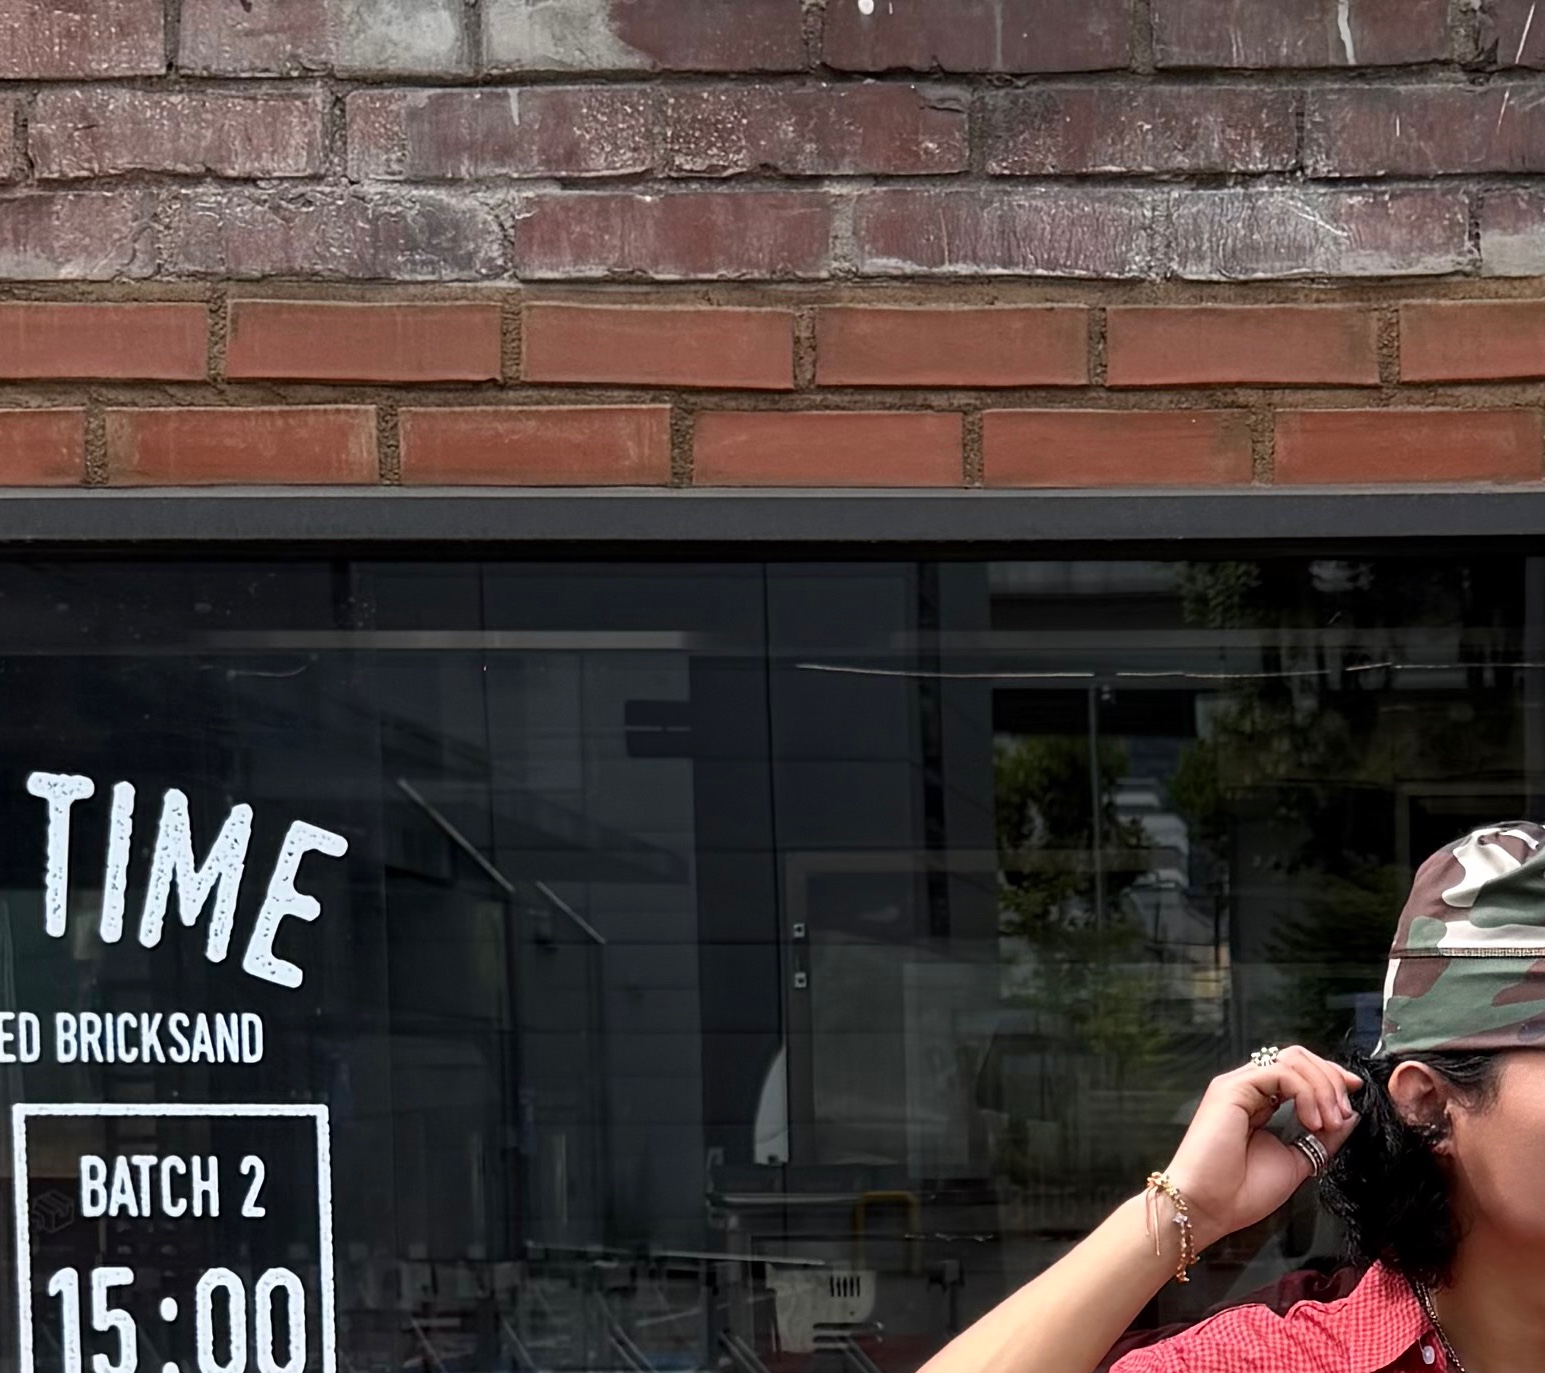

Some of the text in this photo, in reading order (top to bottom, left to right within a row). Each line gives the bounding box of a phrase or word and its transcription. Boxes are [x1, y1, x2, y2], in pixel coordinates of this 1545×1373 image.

[27, 772, 348, 988] TIME
[0, 1012, 263, 1063] ED BRICKSAND
[81, 1155, 266, 1217] BATCH 2
